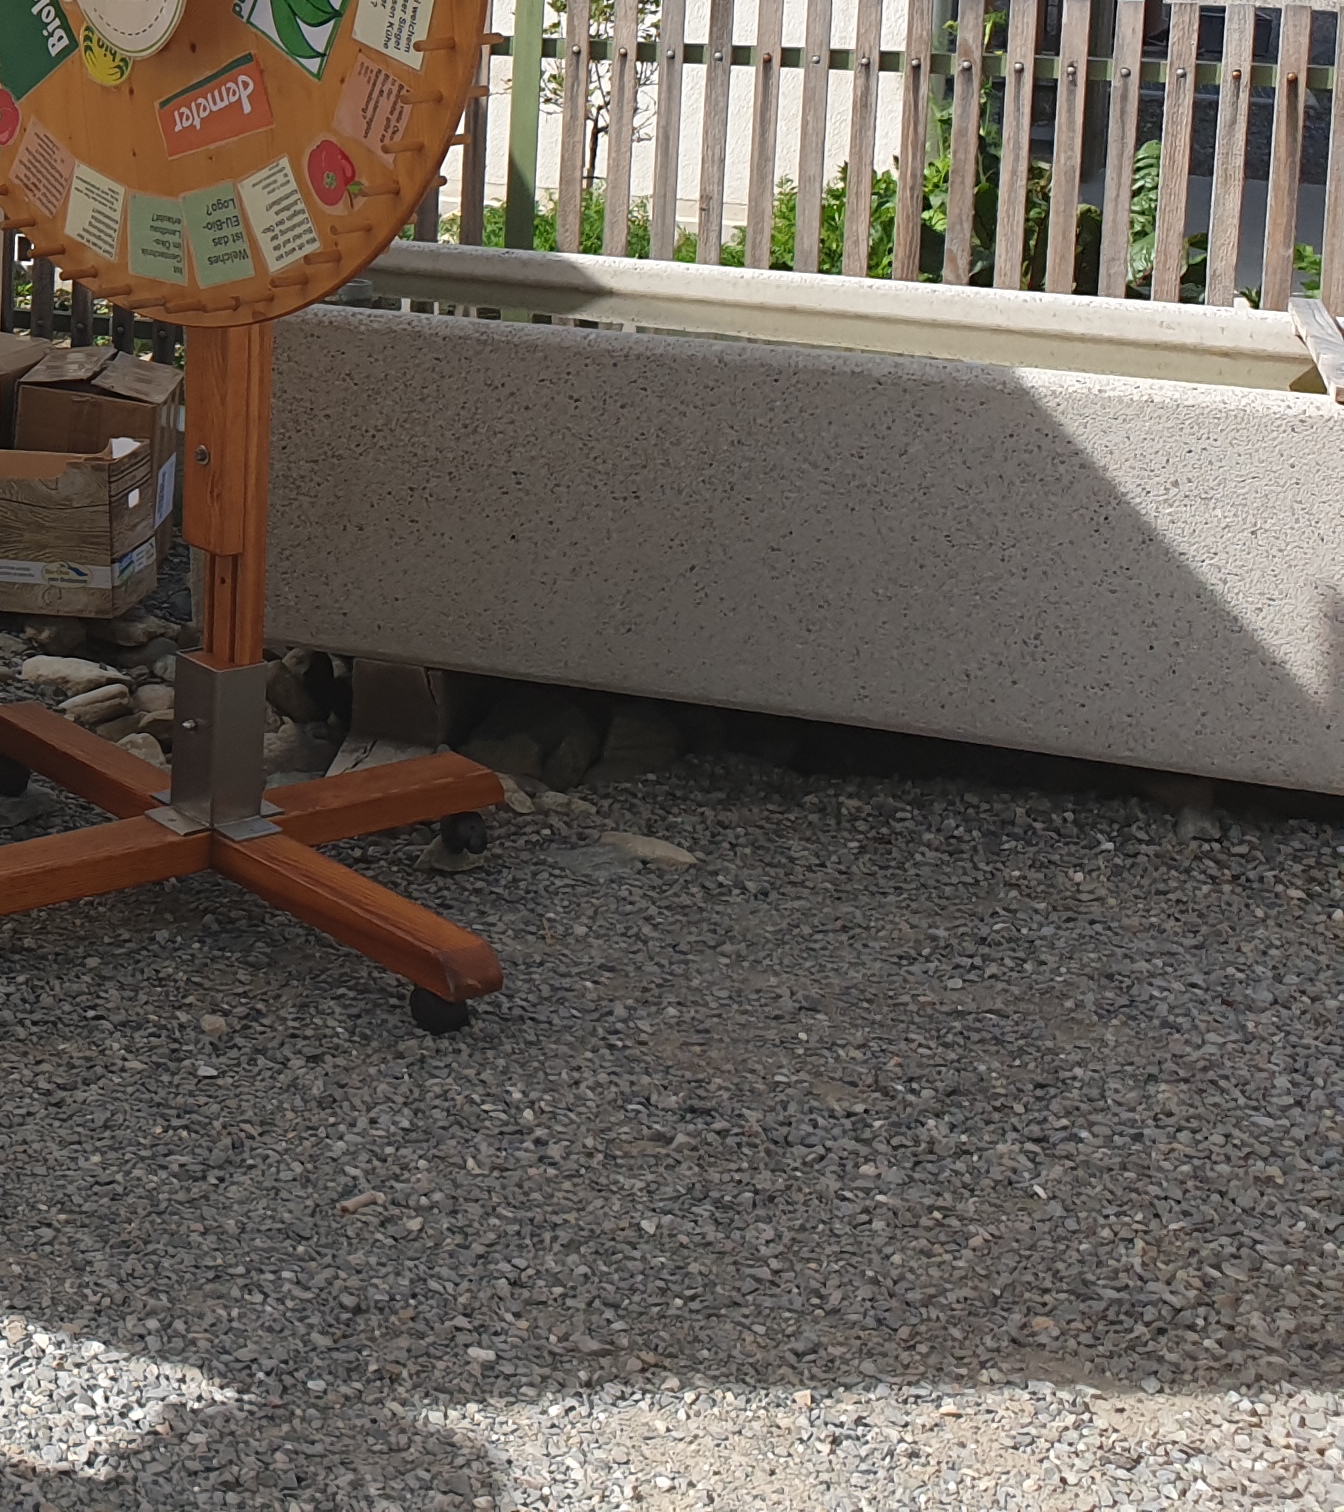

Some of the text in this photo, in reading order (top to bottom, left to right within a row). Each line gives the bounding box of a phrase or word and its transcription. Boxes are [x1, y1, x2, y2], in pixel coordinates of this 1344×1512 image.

[382, 21, 394, 50] Kühe
[391, 15, 406, 50] Siegel
[403, 5, 418, 53] welchem
[173, 73, 255, 134] demeter
[204, 196, 236, 215] Logo?
[201, 214, 240, 233] EU-Bio-
[211, 230, 244, 247] ist das
[206, 247, 248, 266] Welches
